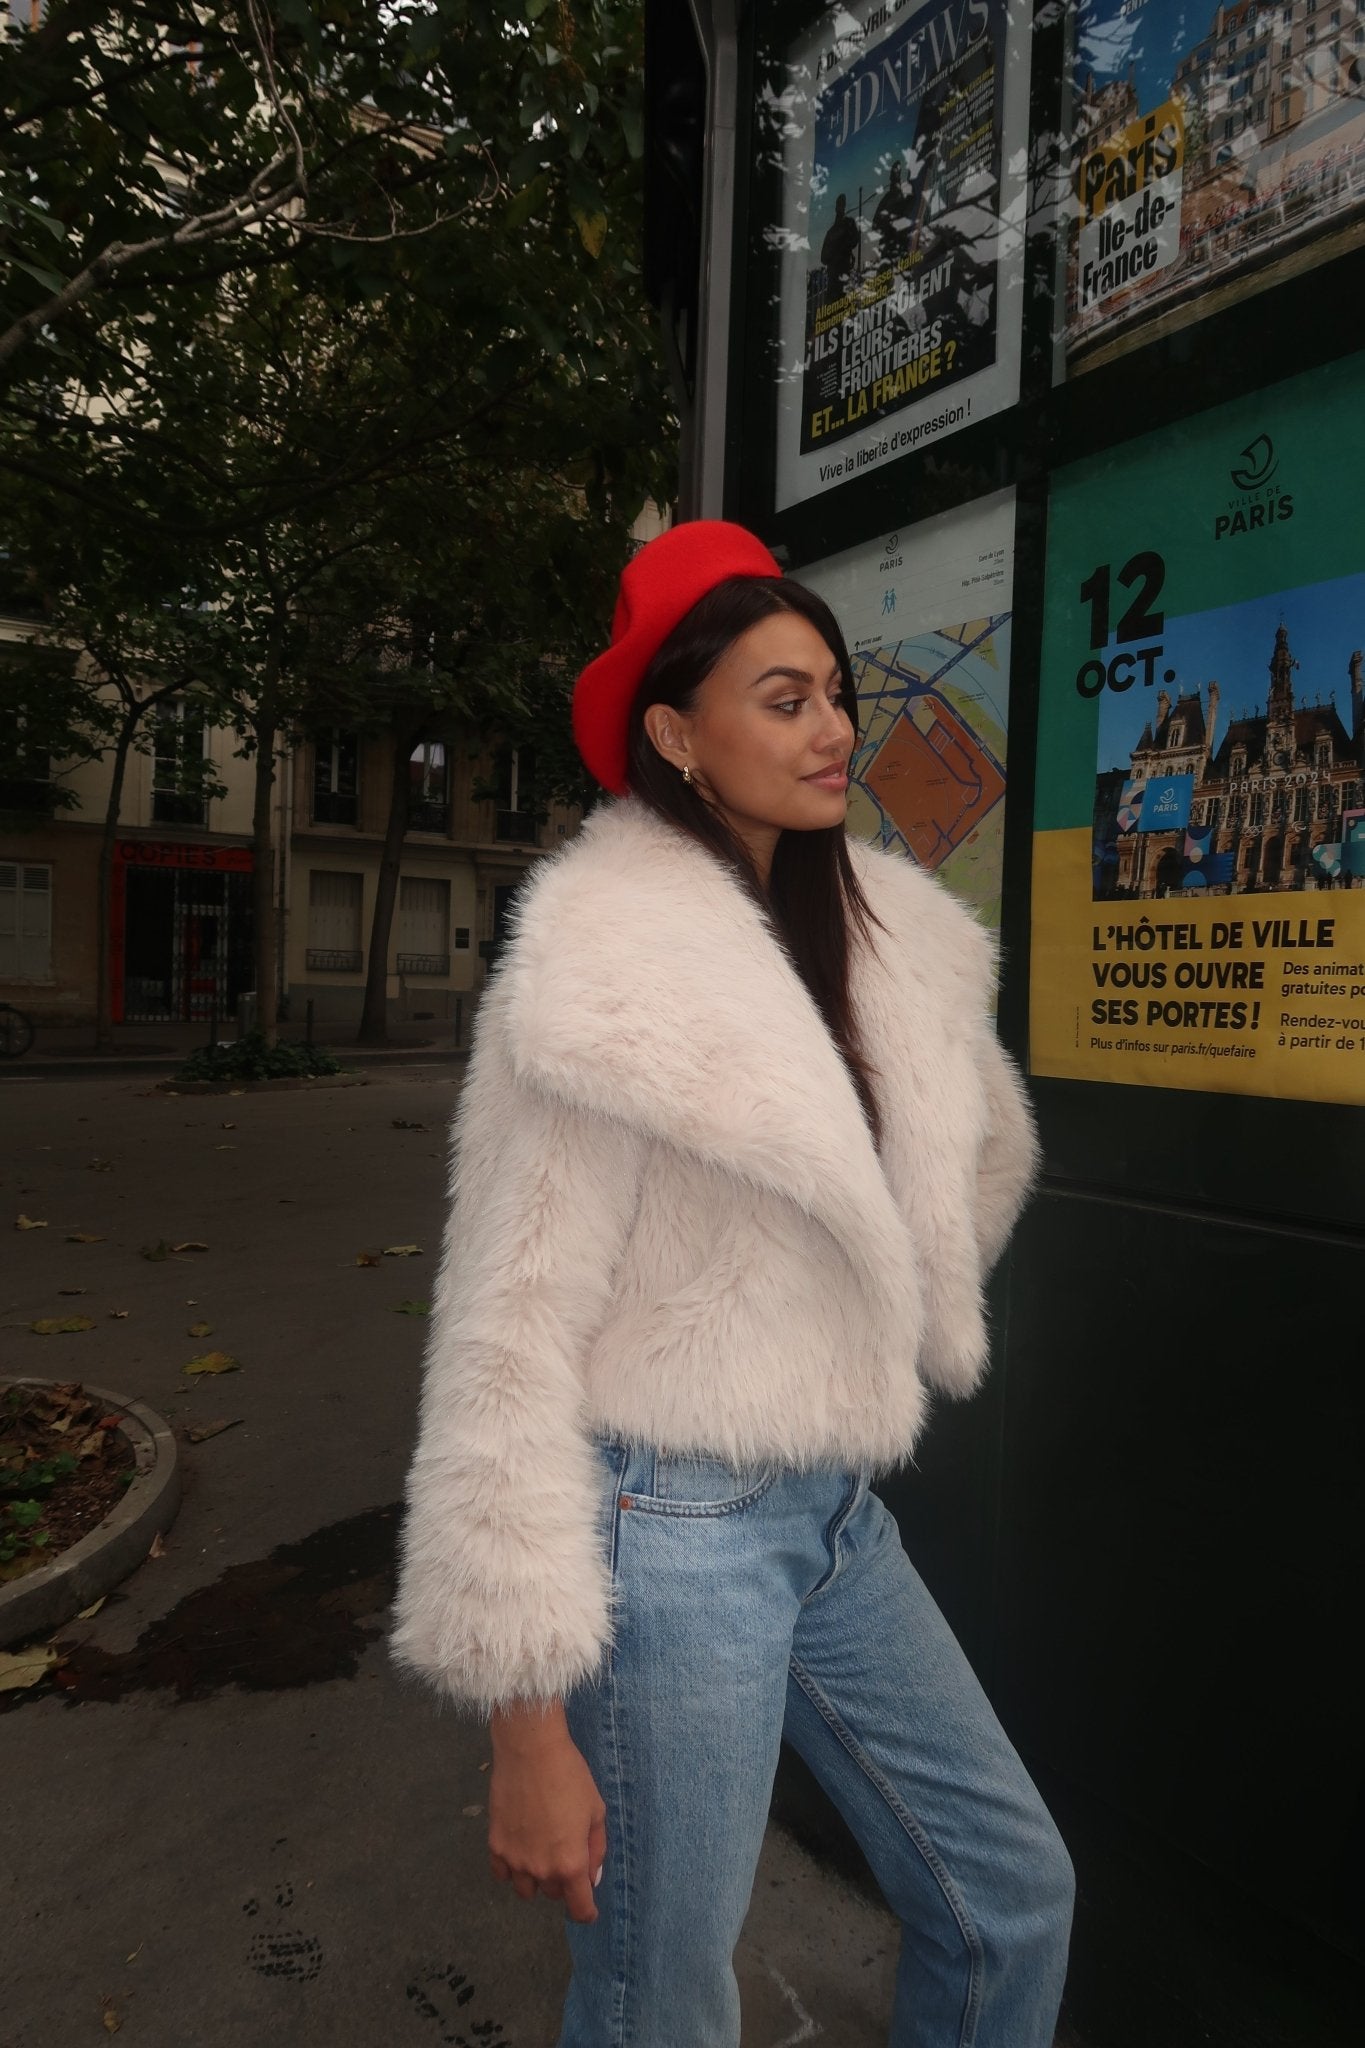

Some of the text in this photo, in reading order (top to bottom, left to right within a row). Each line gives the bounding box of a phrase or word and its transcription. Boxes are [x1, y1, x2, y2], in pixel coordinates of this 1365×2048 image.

[1083, 236, 1158, 307] France
[814, 327, 838, 363] ILS
[841, 321, 894, 373] LEURS
[841, 320, 943, 400] FRONTIÈRES
[811, 406, 845, 438] ET...
[847, 389, 868, 422] LA
[872, 349, 941, 409] FRANCE
[820, 463, 842, 481] Vive
[845, 455, 854, 473] la
[857, 436, 888, 467] liberté
[891, 404, 964, 449] d'expression
[1229, 486, 1280, 510] VILLE DE
[1215, 494, 1293, 540] PARIS
[880, 556, 903, 572] PARIS
[1080, 551, 1165, 650] 12
[1076, 646, 1175, 698] OCT.
[1231, 770, 1331, 794] PARIS 2024
[1153, 803, 1178, 813] PARIS
[1092, 916, 1335, 951] L'HÔTEL DE VILLE
[1091, 962, 1265, 989] VOUS OUVRE
[1283, 961, 1364, 976] Des animat
[1281, 980, 1346, 997] gratuites
[1090, 999, 1139, 1025] SES
[1091, 1037, 1256, 1059] Plus d'infos sur paris.fr/quefaire
[1278, 1031, 1286, 1046] à
[1290, 1034, 1331, 1050] partir
[1336, 1035, 1355, 1050] de
